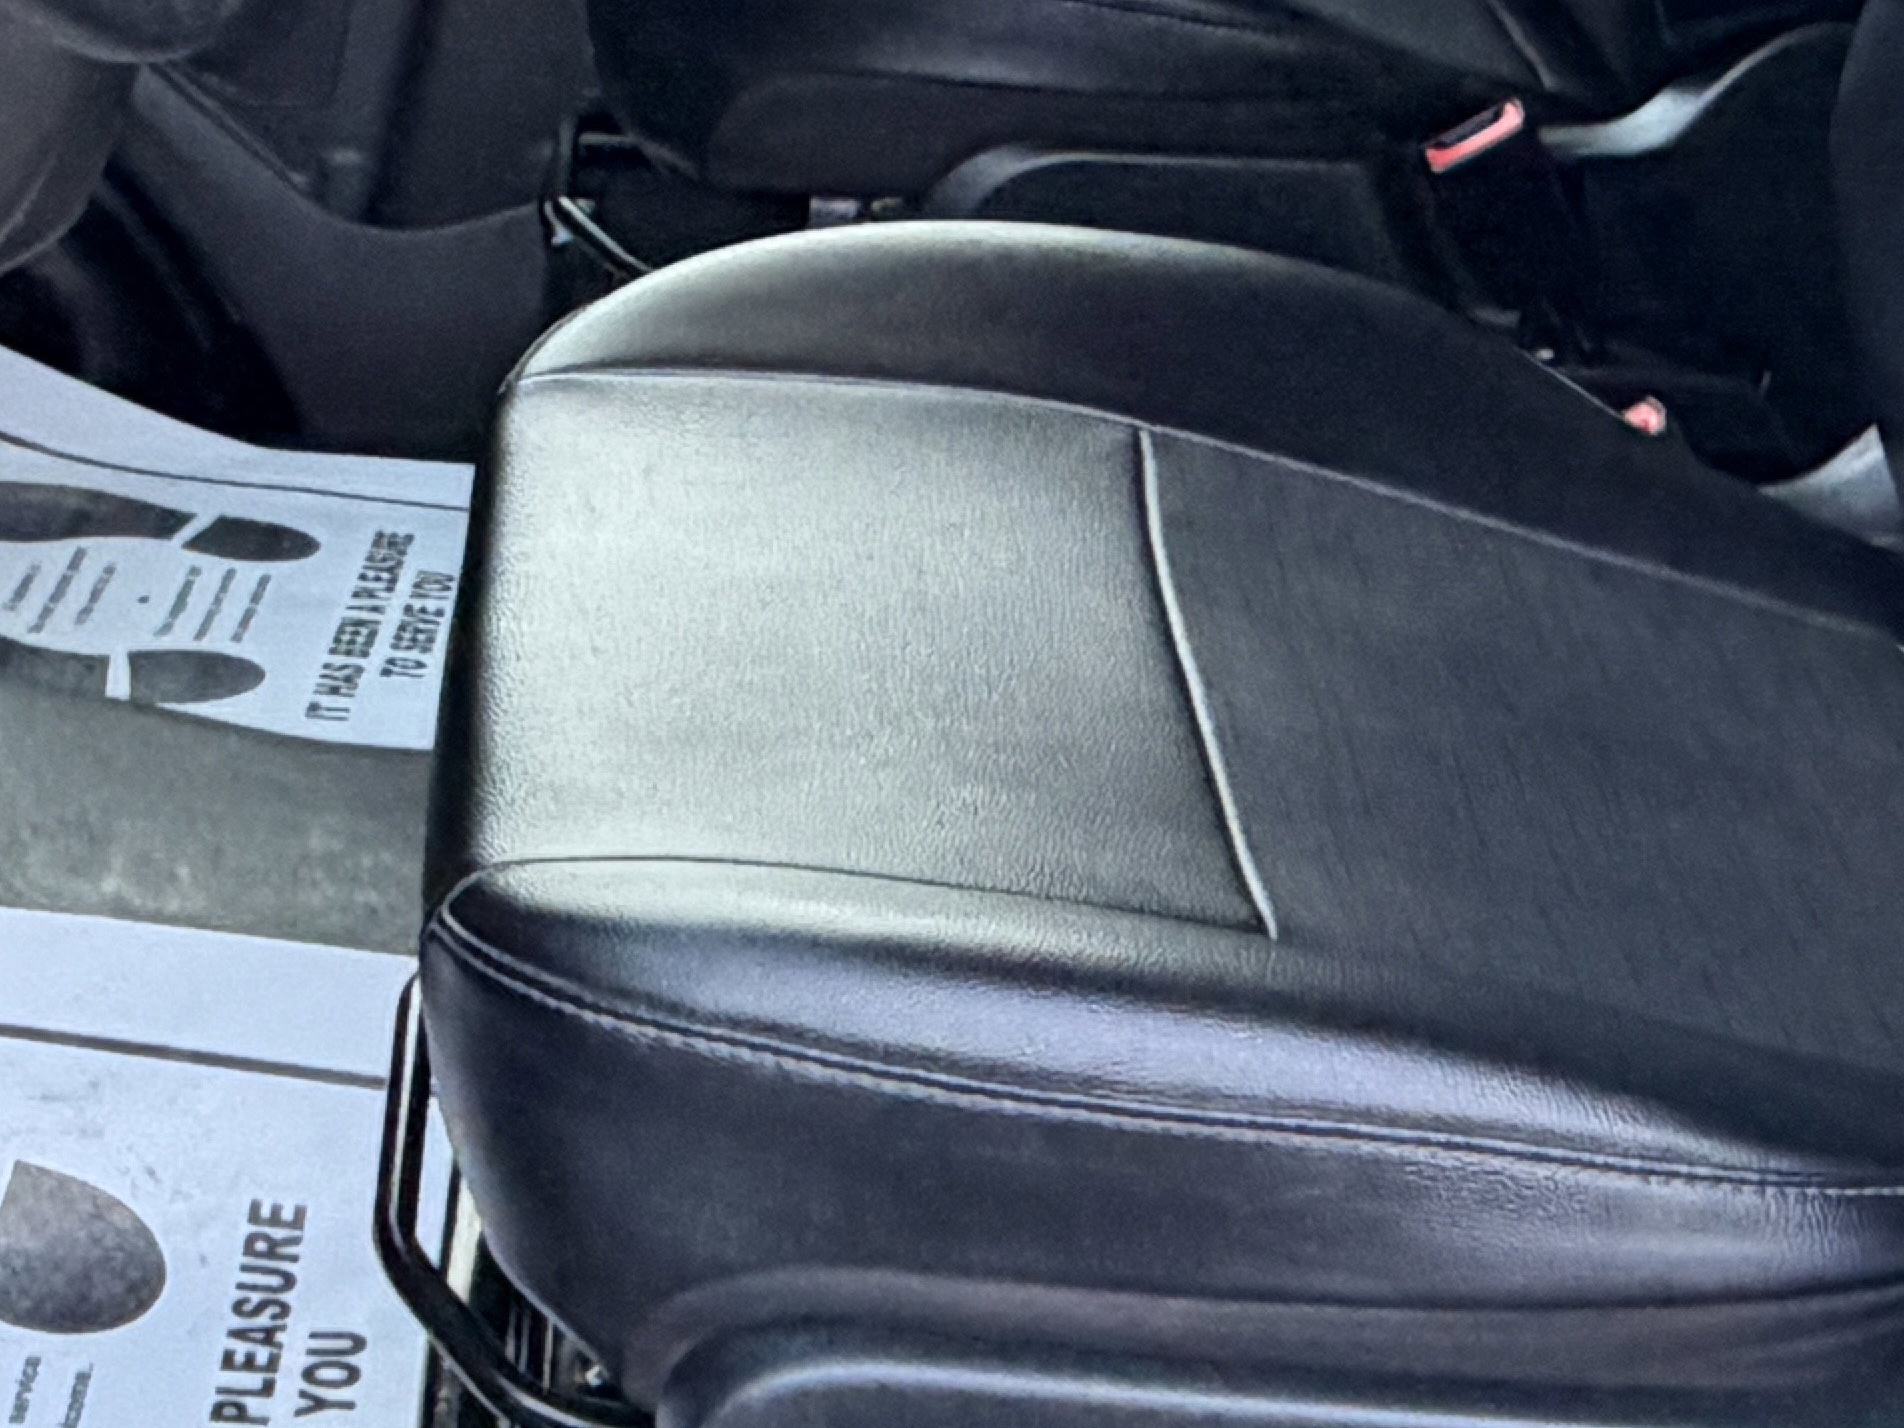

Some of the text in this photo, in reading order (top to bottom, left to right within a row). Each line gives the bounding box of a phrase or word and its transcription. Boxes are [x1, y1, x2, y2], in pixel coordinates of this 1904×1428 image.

[328, 617, 382, 659] BEEN
[379, 570, 455, 679] TO SERVE YOU
[304, 701, 352, 721] IT
[312, 662, 365, 698] HAS
[209, 1198, 307, 1426] PLEASURE
[8, 1356, 42, 1424] service
[294, 1330, 367, 1417] YOU
